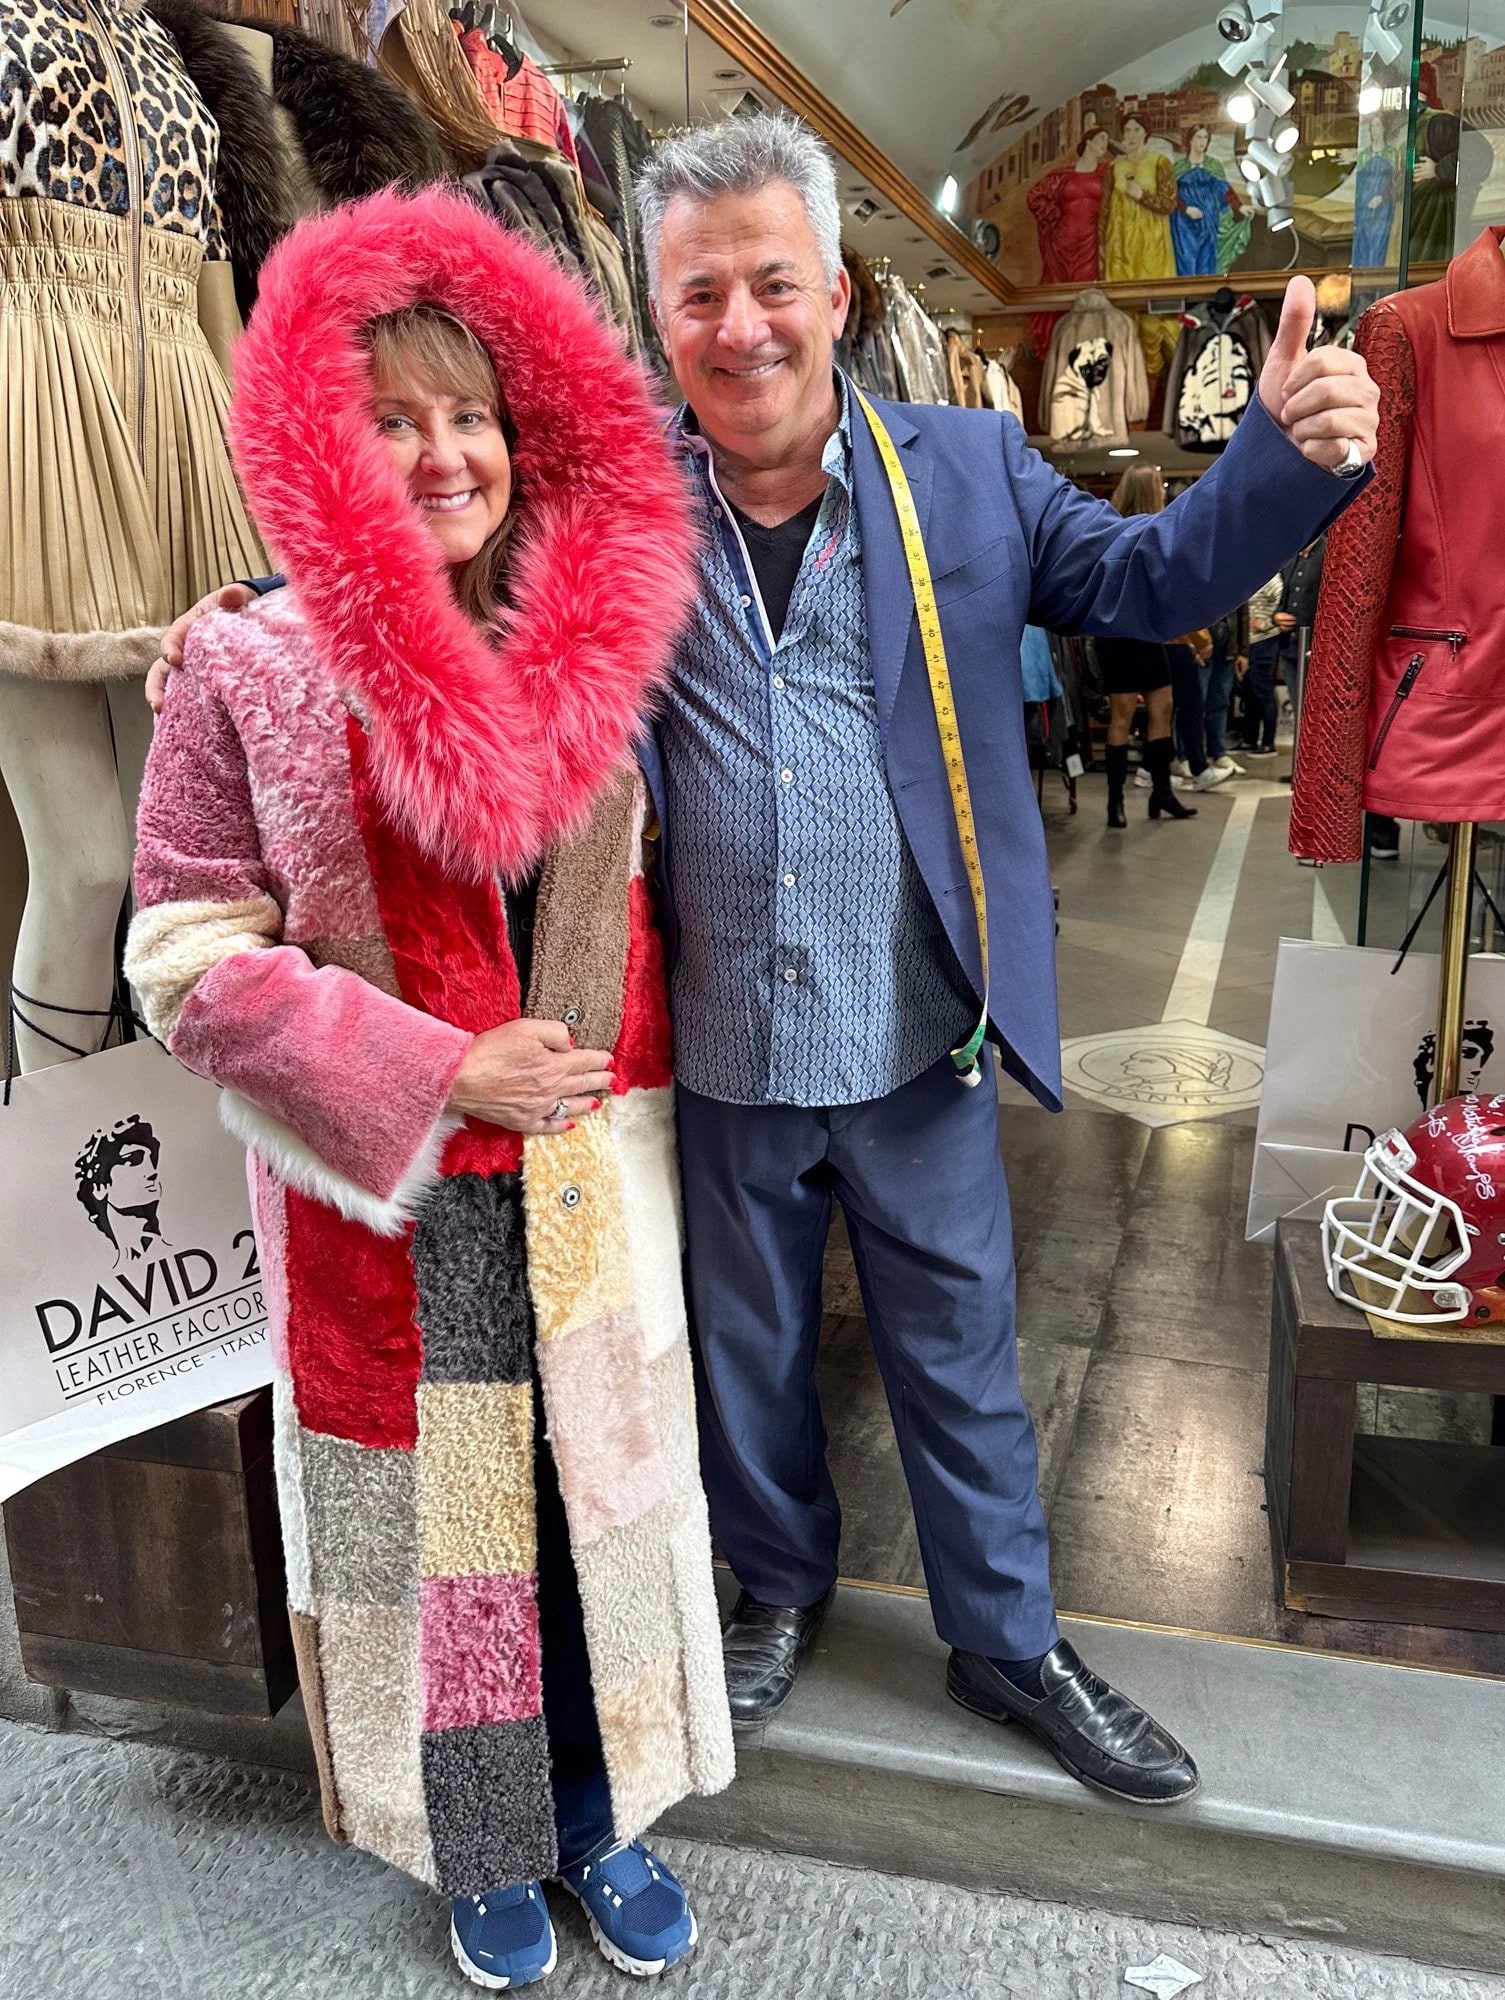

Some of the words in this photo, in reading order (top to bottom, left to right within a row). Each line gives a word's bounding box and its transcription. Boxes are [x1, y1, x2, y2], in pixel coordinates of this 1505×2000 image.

[913, 552, 921, 561] 37
[918, 577, 926, 587] 38
[923, 602, 931, 612] 39
[928, 628, 936, 638] 40
[933, 654, 940, 663] 41
[937, 680, 945, 690] 42
[942, 706, 949, 716] 43
[947, 732, 954, 742] 44
[951, 757, 959, 768] 45
[956, 783, 963, 793] 46
[960, 809, 968, 818] 47
[965, 835, 971, 845] 48
[35, 1248, 218, 1354] DAVID
[232, 1229, 261, 1280] 2
[56, 1332, 163, 1392] LEATHER
[172, 1291, 268, 1345] FACTOR
[96, 1354, 204, 1405] FLORENCE
[220, 1328, 266, 1356] ITALY
